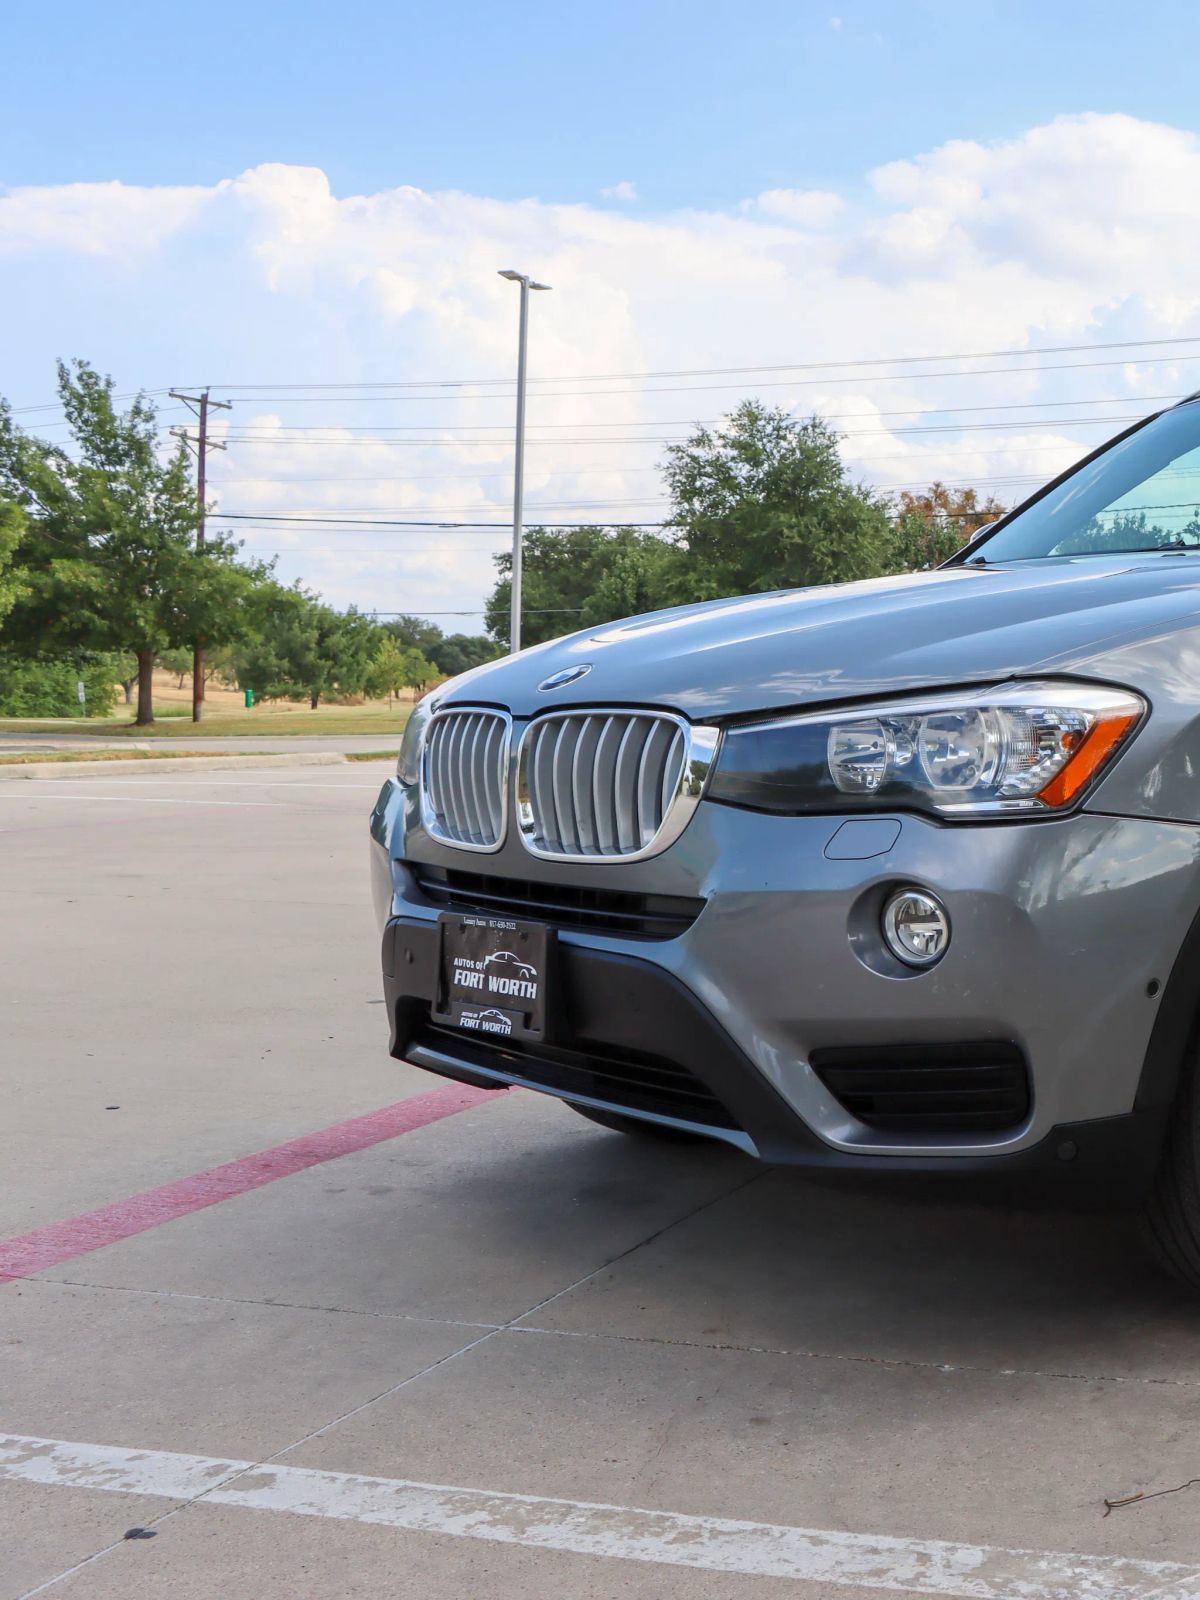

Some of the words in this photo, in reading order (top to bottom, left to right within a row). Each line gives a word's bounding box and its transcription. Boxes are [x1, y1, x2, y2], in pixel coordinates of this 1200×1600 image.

[454, 958, 475, 969] AUTOS
[454, 969, 485, 990] FORT
[488, 975, 538, 999] WORTH
[460, 1017, 480, 1029] FORT
[482, 1020, 512, 1035] WORTH
